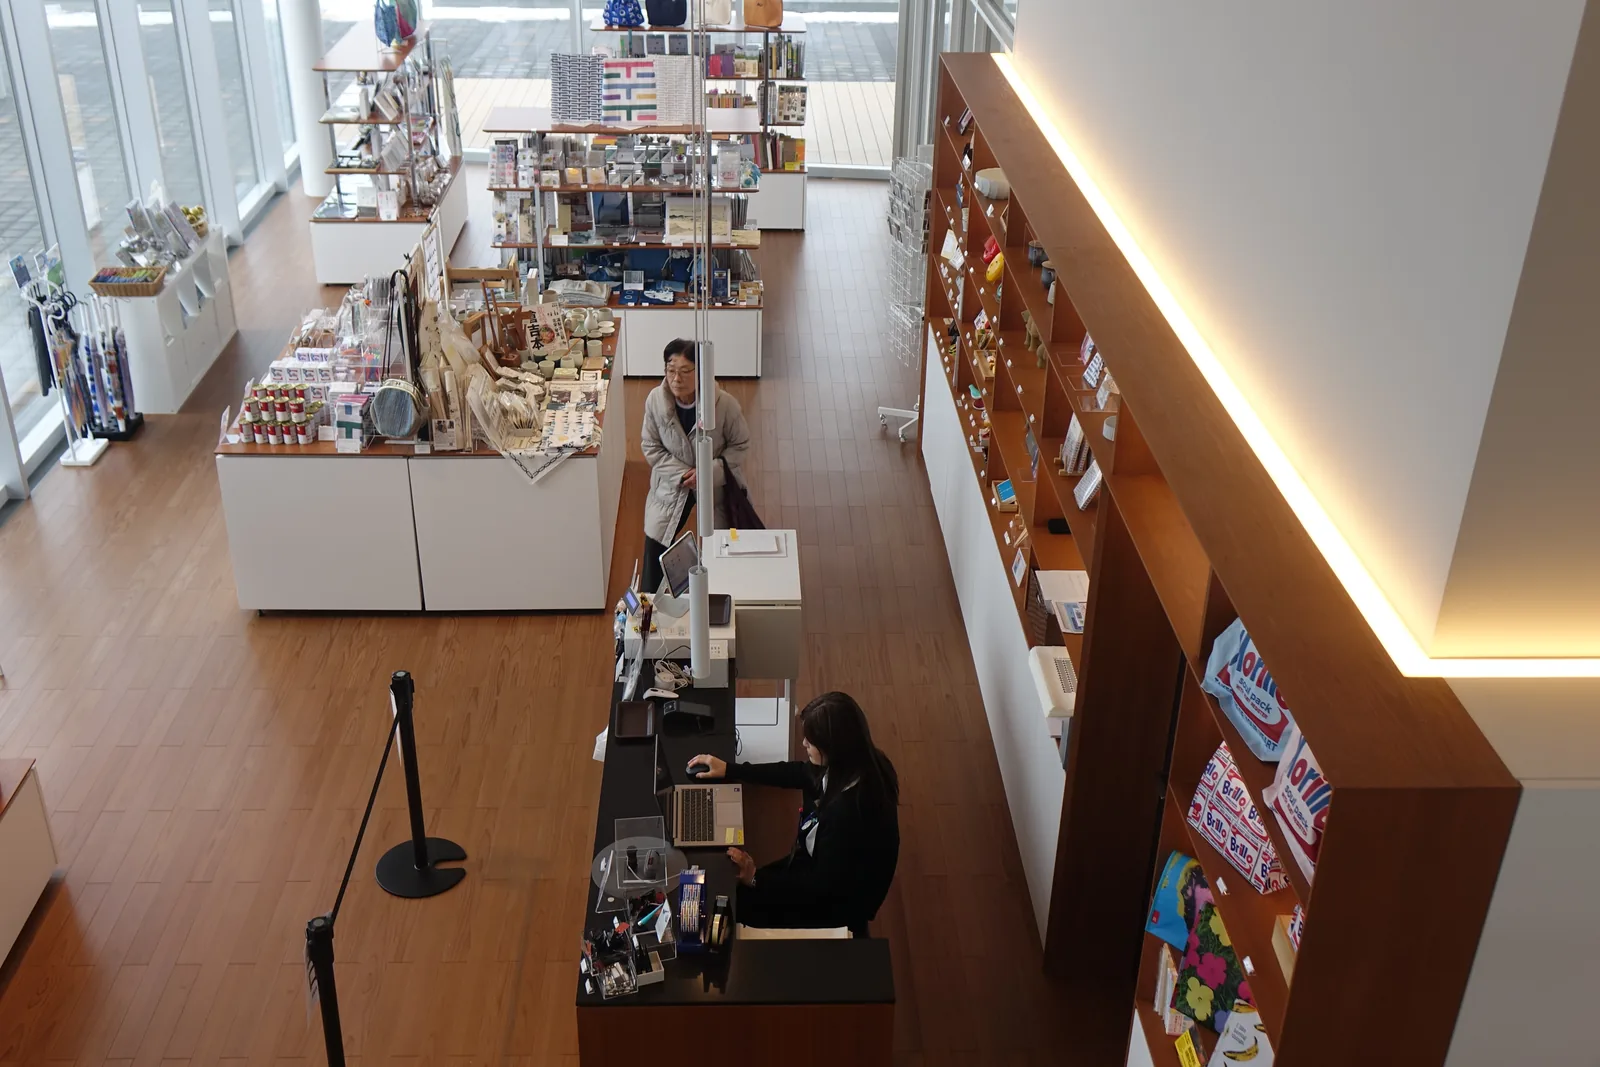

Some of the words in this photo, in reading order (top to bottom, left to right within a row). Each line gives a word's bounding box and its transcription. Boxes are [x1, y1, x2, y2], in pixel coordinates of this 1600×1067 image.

[1249, 692, 1273, 714] pack
[1222, 780, 1247, 807] Brillo
[1206, 811, 1227, 839] Brillo
[1230, 836, 1253, 864] Brillo
